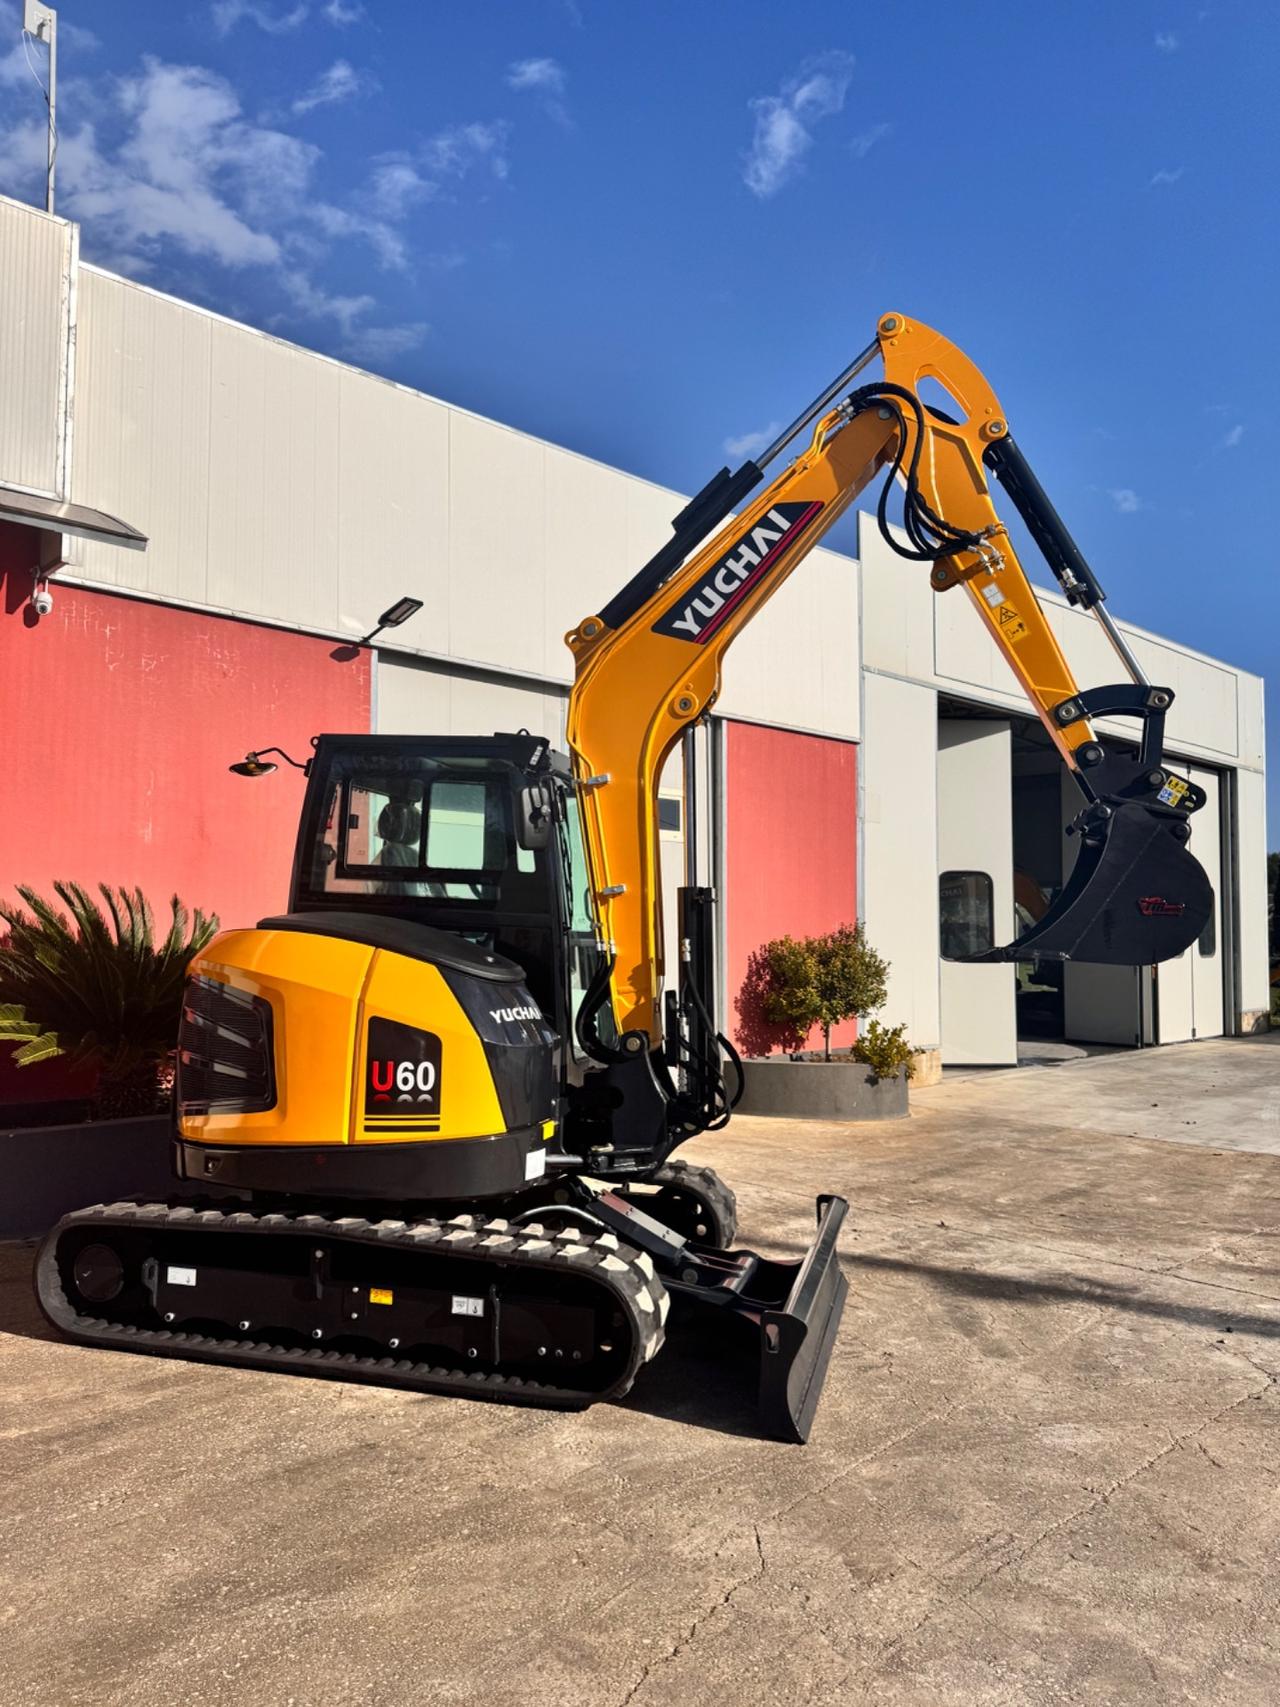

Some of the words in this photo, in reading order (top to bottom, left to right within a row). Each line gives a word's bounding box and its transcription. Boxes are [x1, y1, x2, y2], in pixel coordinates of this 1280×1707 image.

[673, 508, 792, 635] YUCHAI
[489, 1006, 542, 1024] YUCHAI
[372, 1060, 436, 1091] U60
